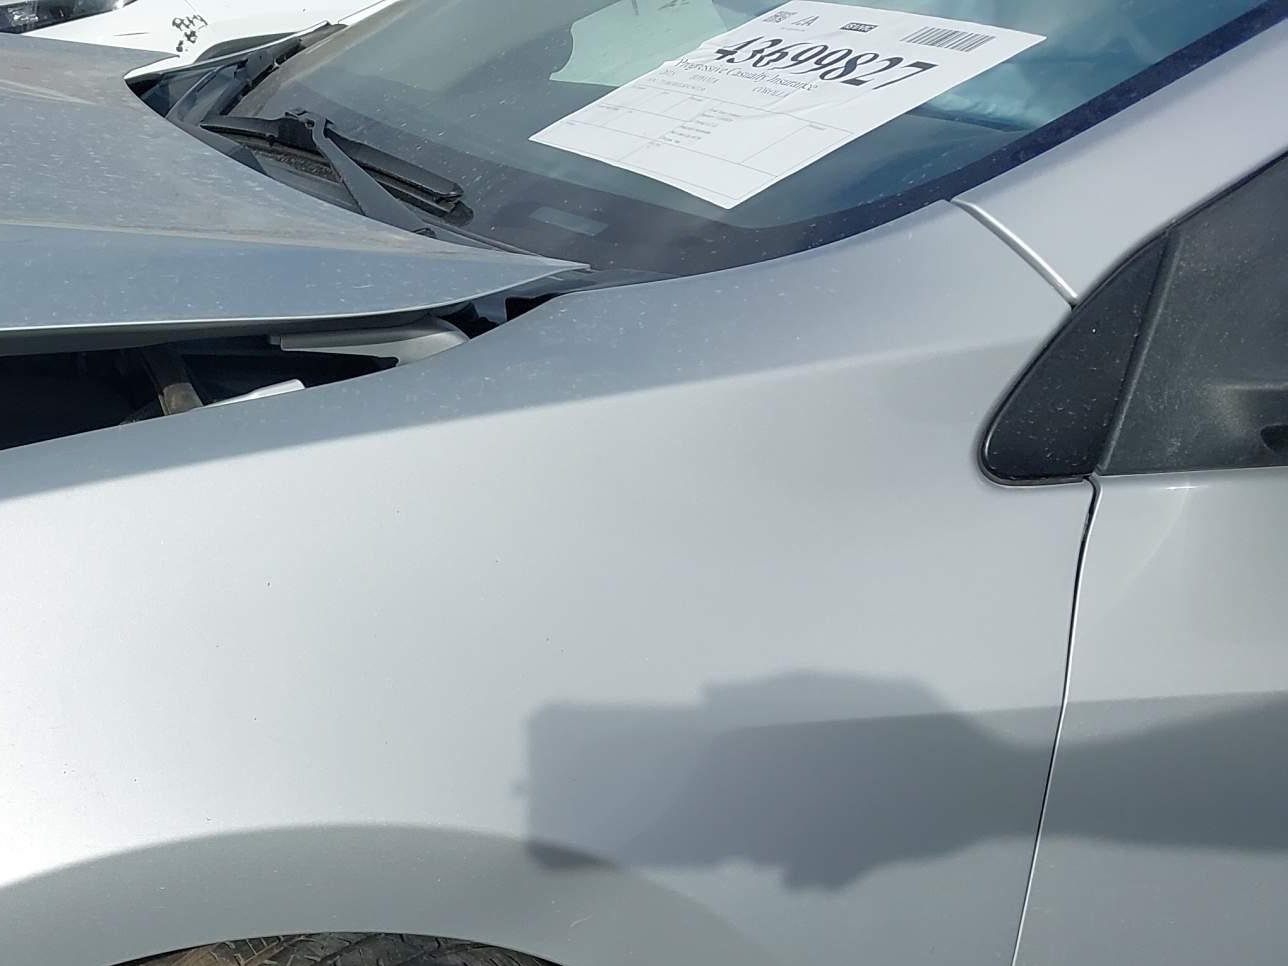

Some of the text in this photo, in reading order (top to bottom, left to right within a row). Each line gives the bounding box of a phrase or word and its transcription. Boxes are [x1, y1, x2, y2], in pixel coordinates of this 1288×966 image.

[674, 57, 727, 75] Progressive
[726, 67, 766, 84] Casualty
[766, 74, 819, 91] Insurance
[715, 36, 938, 90] 43699827
